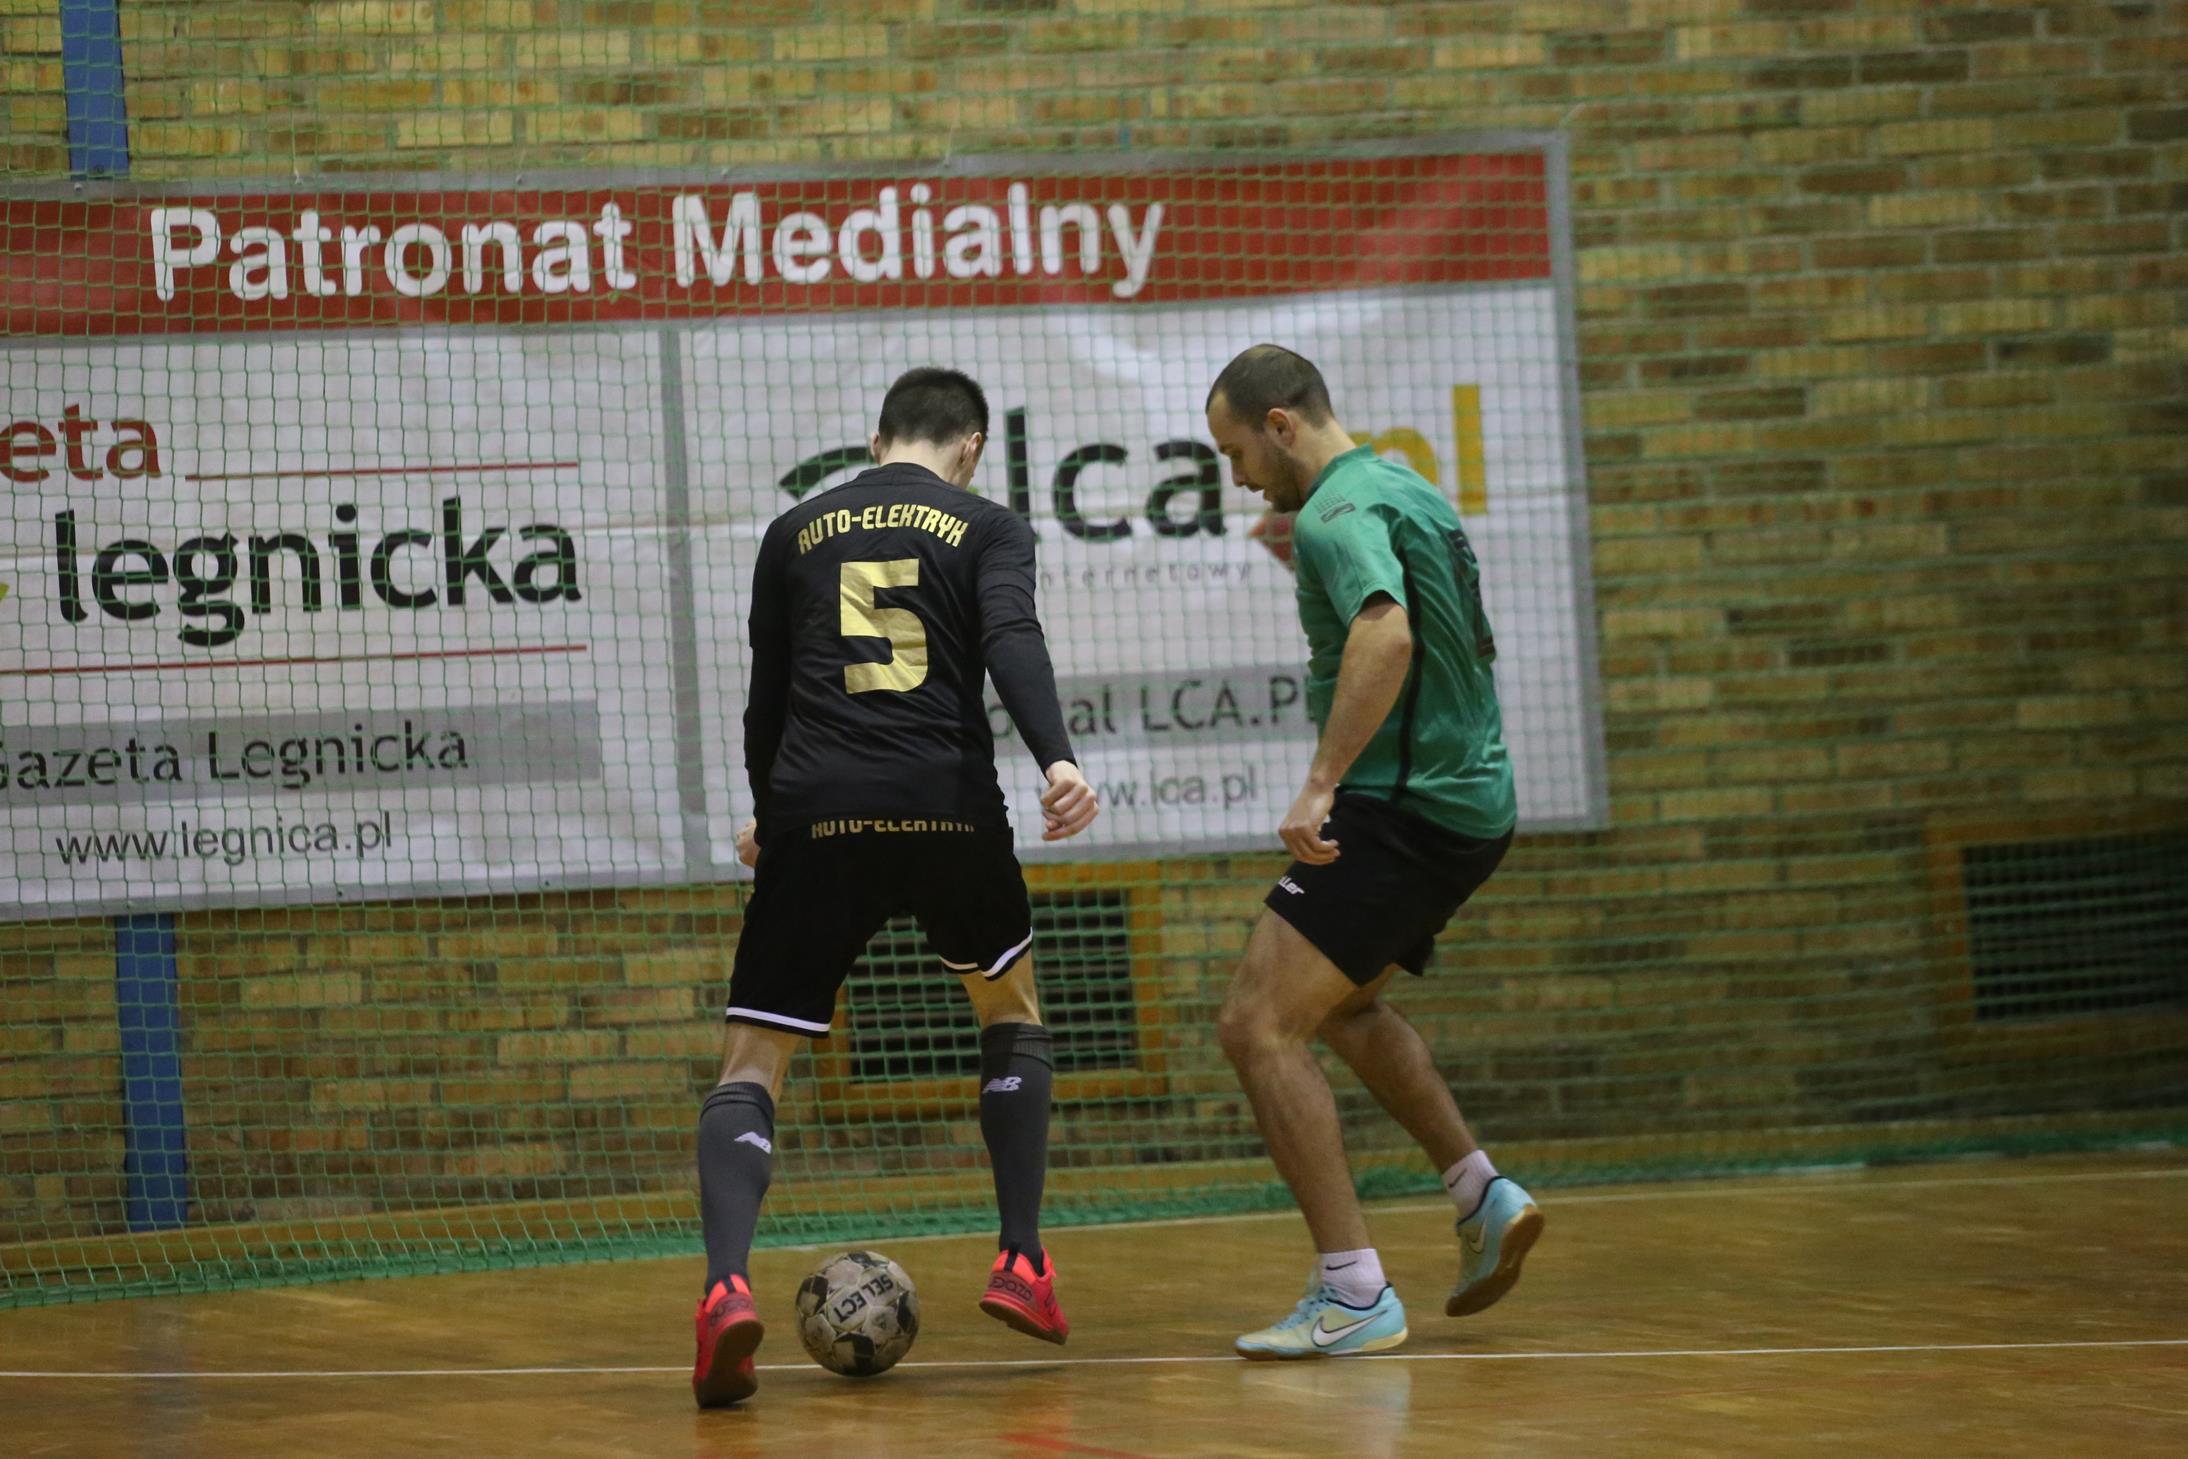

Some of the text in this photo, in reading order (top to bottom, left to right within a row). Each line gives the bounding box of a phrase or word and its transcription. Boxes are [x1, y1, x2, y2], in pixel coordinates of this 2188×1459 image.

[150, 181, 1164, 300] Patronat Medialny
[798, 504, 968, 555] AUTO-ELEKTRYK
[54, 497, 582, 647] legnicka
[1040, 561, 1253, 590] nternetowy
[840, 558, 928, 694] 5
[208, 721, 468, 789] Legnicka
[1036, 763, 1258, 810] w.lca.pl
[55, 812, 392, 868] www.legnica.pl
[833, 1273, 895, 1324] SELECT
